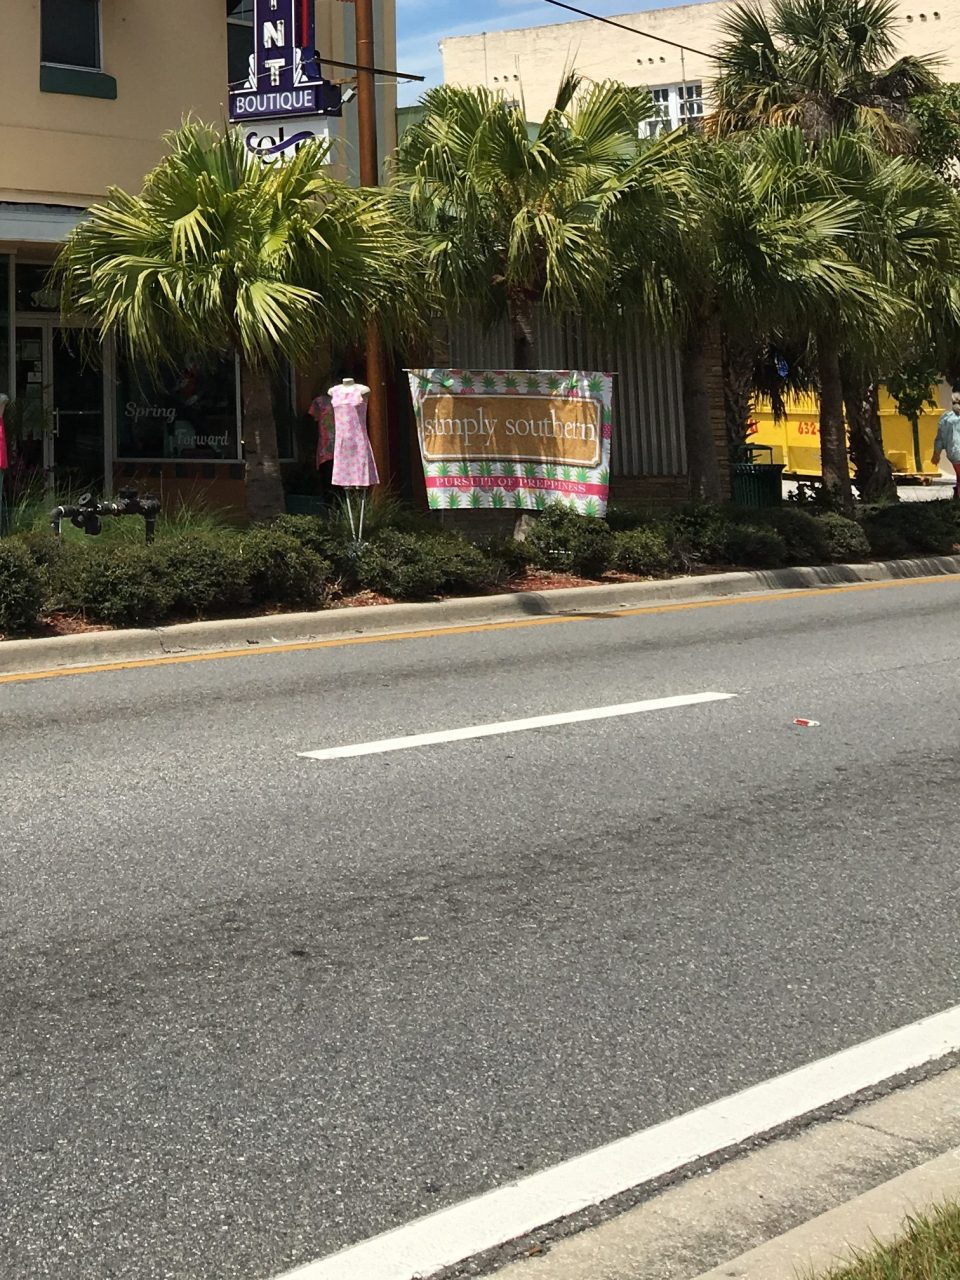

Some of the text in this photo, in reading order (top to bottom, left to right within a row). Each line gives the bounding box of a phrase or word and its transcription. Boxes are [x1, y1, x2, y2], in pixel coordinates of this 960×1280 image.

[236, 90, 313, 113] BOUTIQUE
[124, 401, 177, 423] Spring
[424, 407, 596, 446] simply southern
[436, 477, 587, 493] PURSUIT OF PREPPINESS
